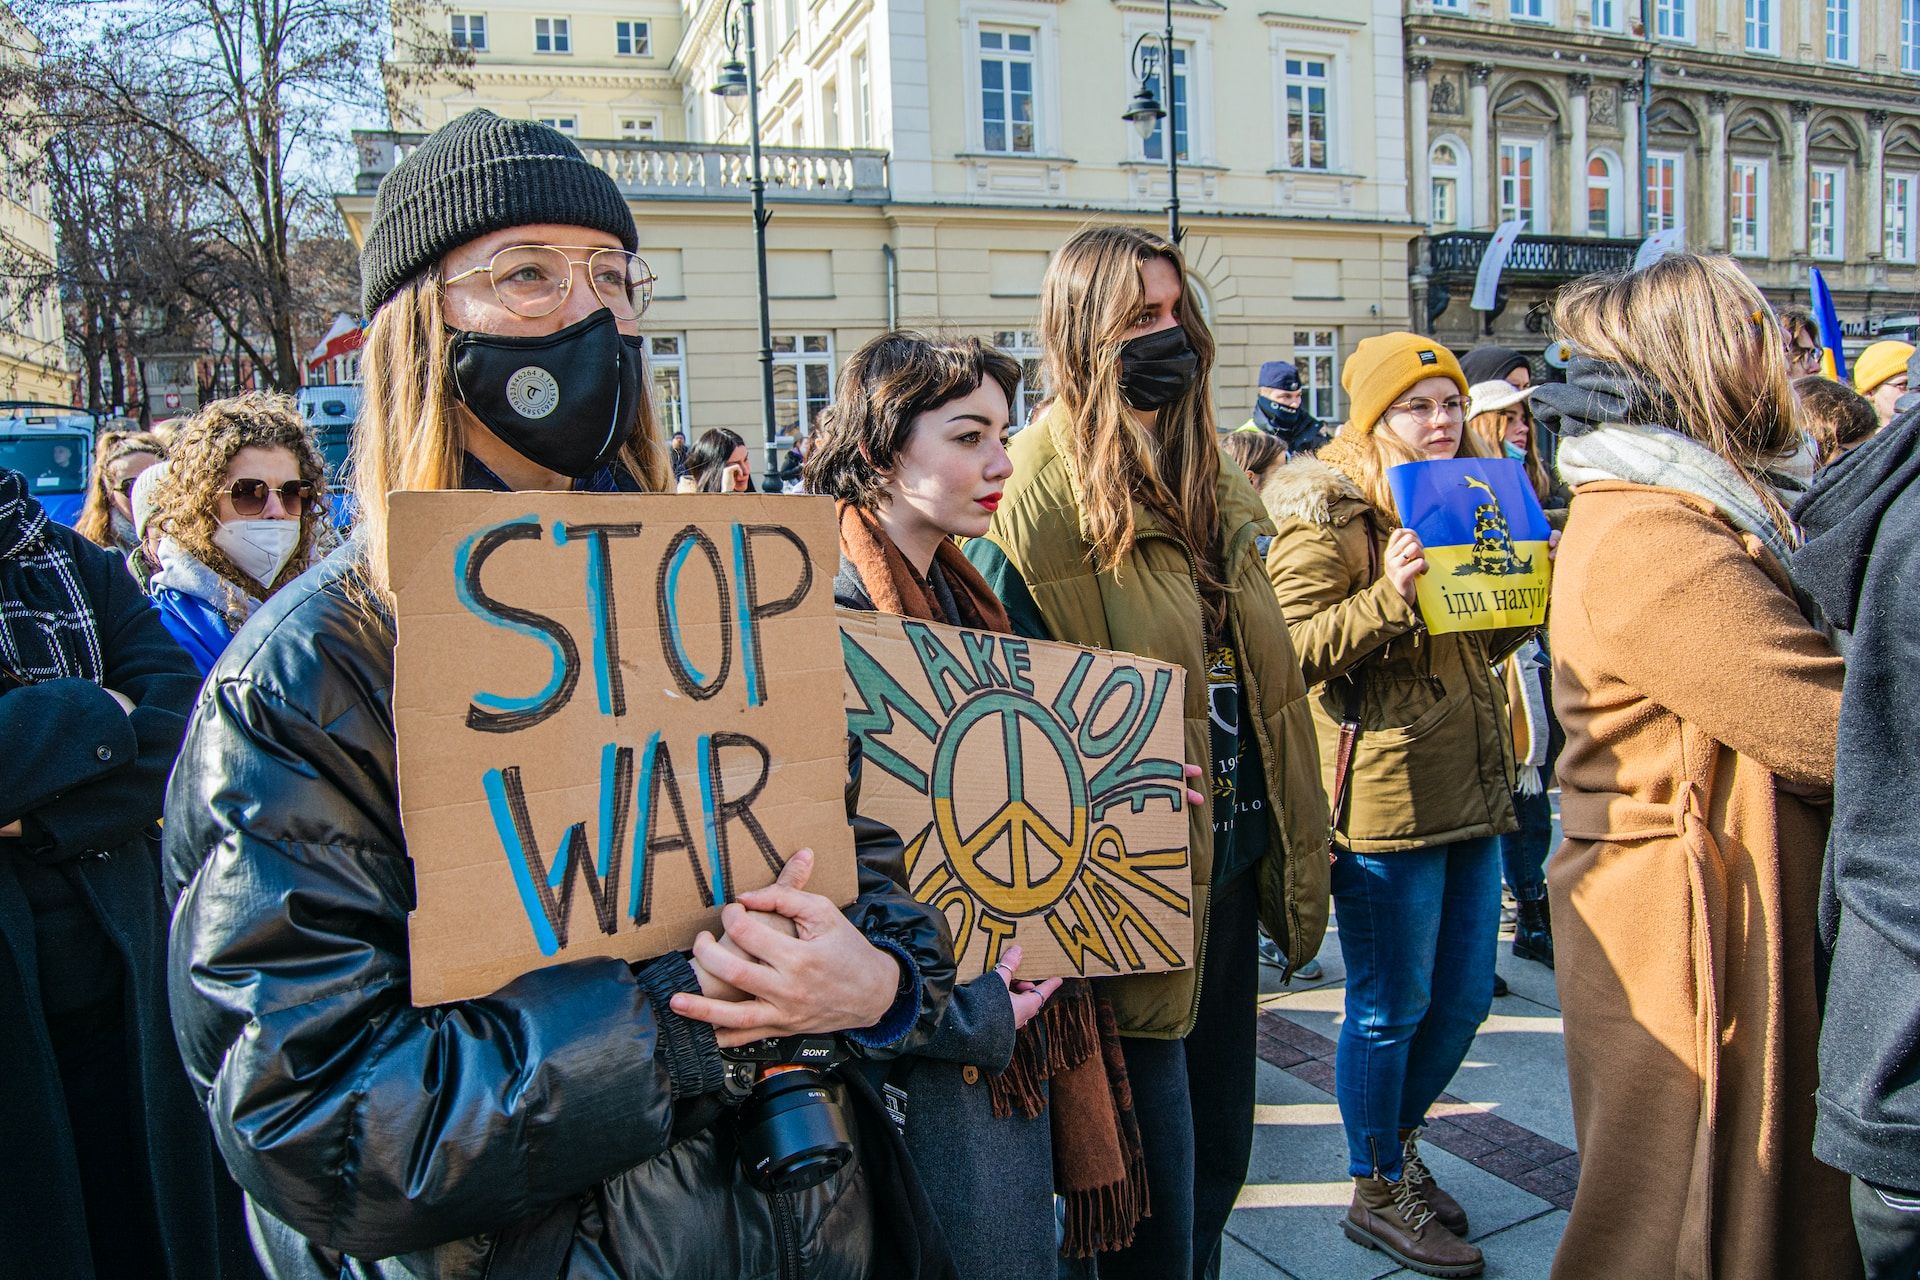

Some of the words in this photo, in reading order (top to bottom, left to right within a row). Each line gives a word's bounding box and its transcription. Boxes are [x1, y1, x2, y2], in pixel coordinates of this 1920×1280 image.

[454, 514, 813, 733] STOP
[1441, 586, 1488, 620] іди
[1491, 579, 1545, 619] нахуй
[840, 621, 1034, 796] MAKE
[1052, 651, 1184, 822] LOVE
[483, 730, 785, 956] WAR
[1044, 824, 1191, 976] WAR
[802, 1049, 829, 1057] SONY
